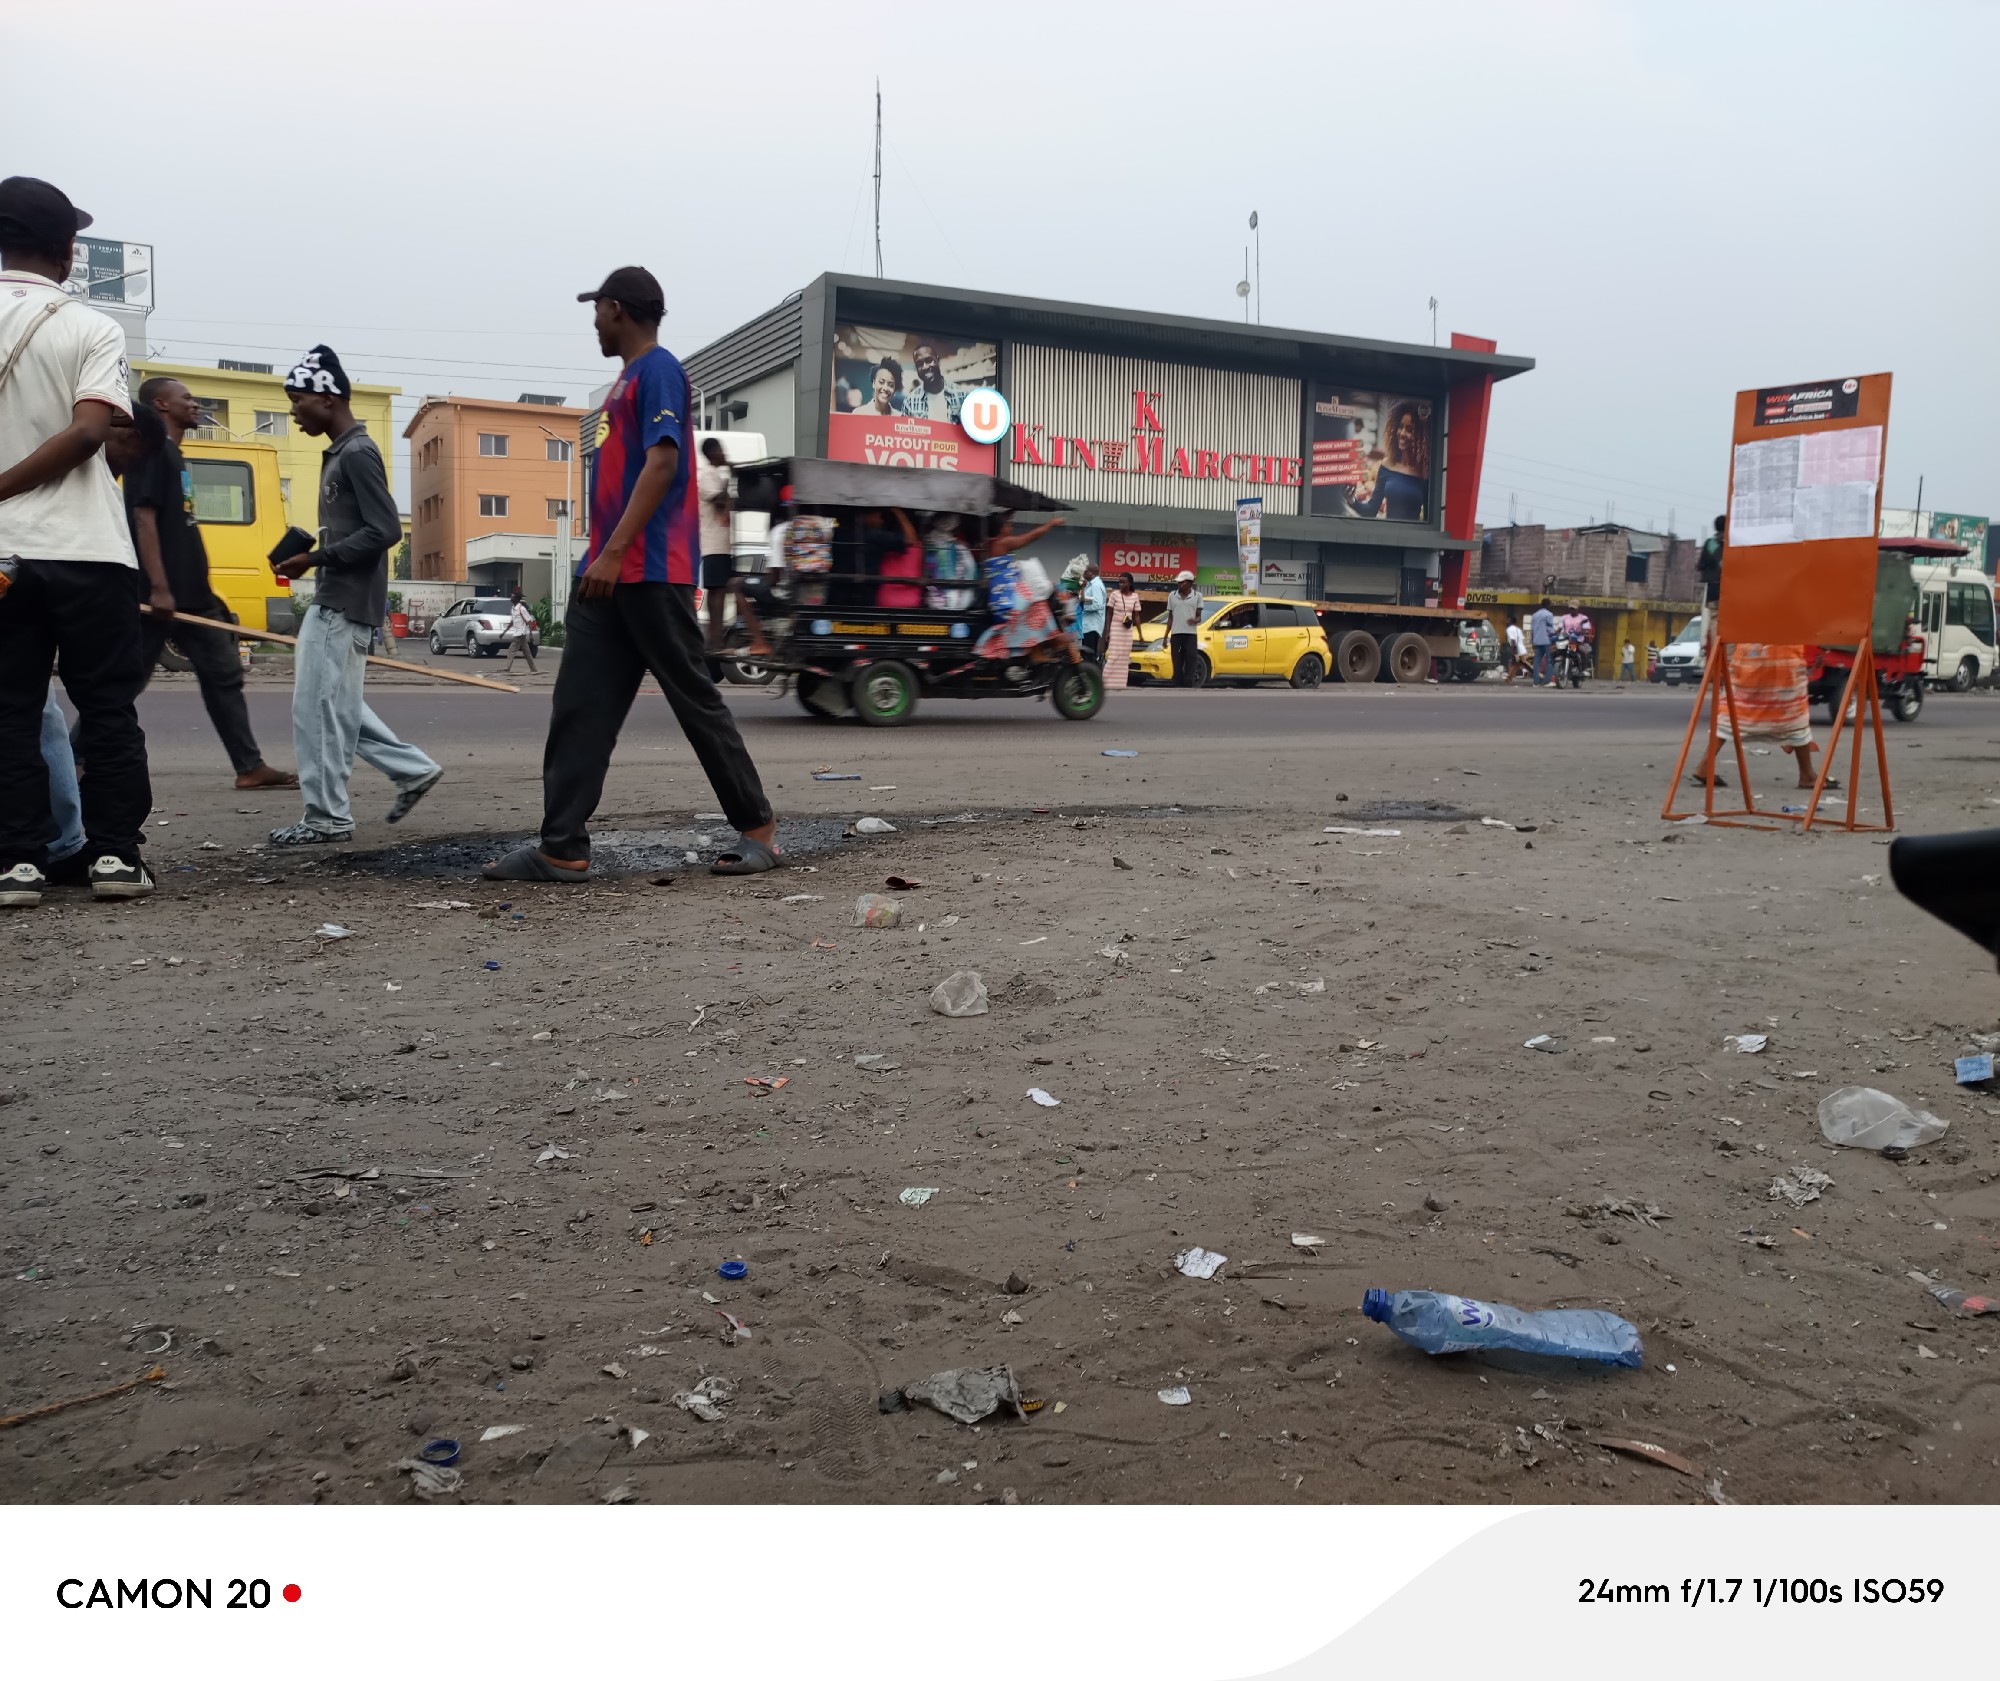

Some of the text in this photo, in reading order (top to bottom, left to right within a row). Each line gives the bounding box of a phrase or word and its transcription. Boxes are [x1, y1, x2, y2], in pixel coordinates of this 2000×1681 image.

[973, 403, 998, 431] U
[1131, 390, 1165, 431] K
[865, 434, 956, 452] PARTOUT POUR
[1010, 422, 1304, 487] KIN MARCHE
[864, 448, 958, 472] VOUS
[1114, 550, 1180, 568] SORTIE
[1466, 594, 1498, 603] DIVERS
